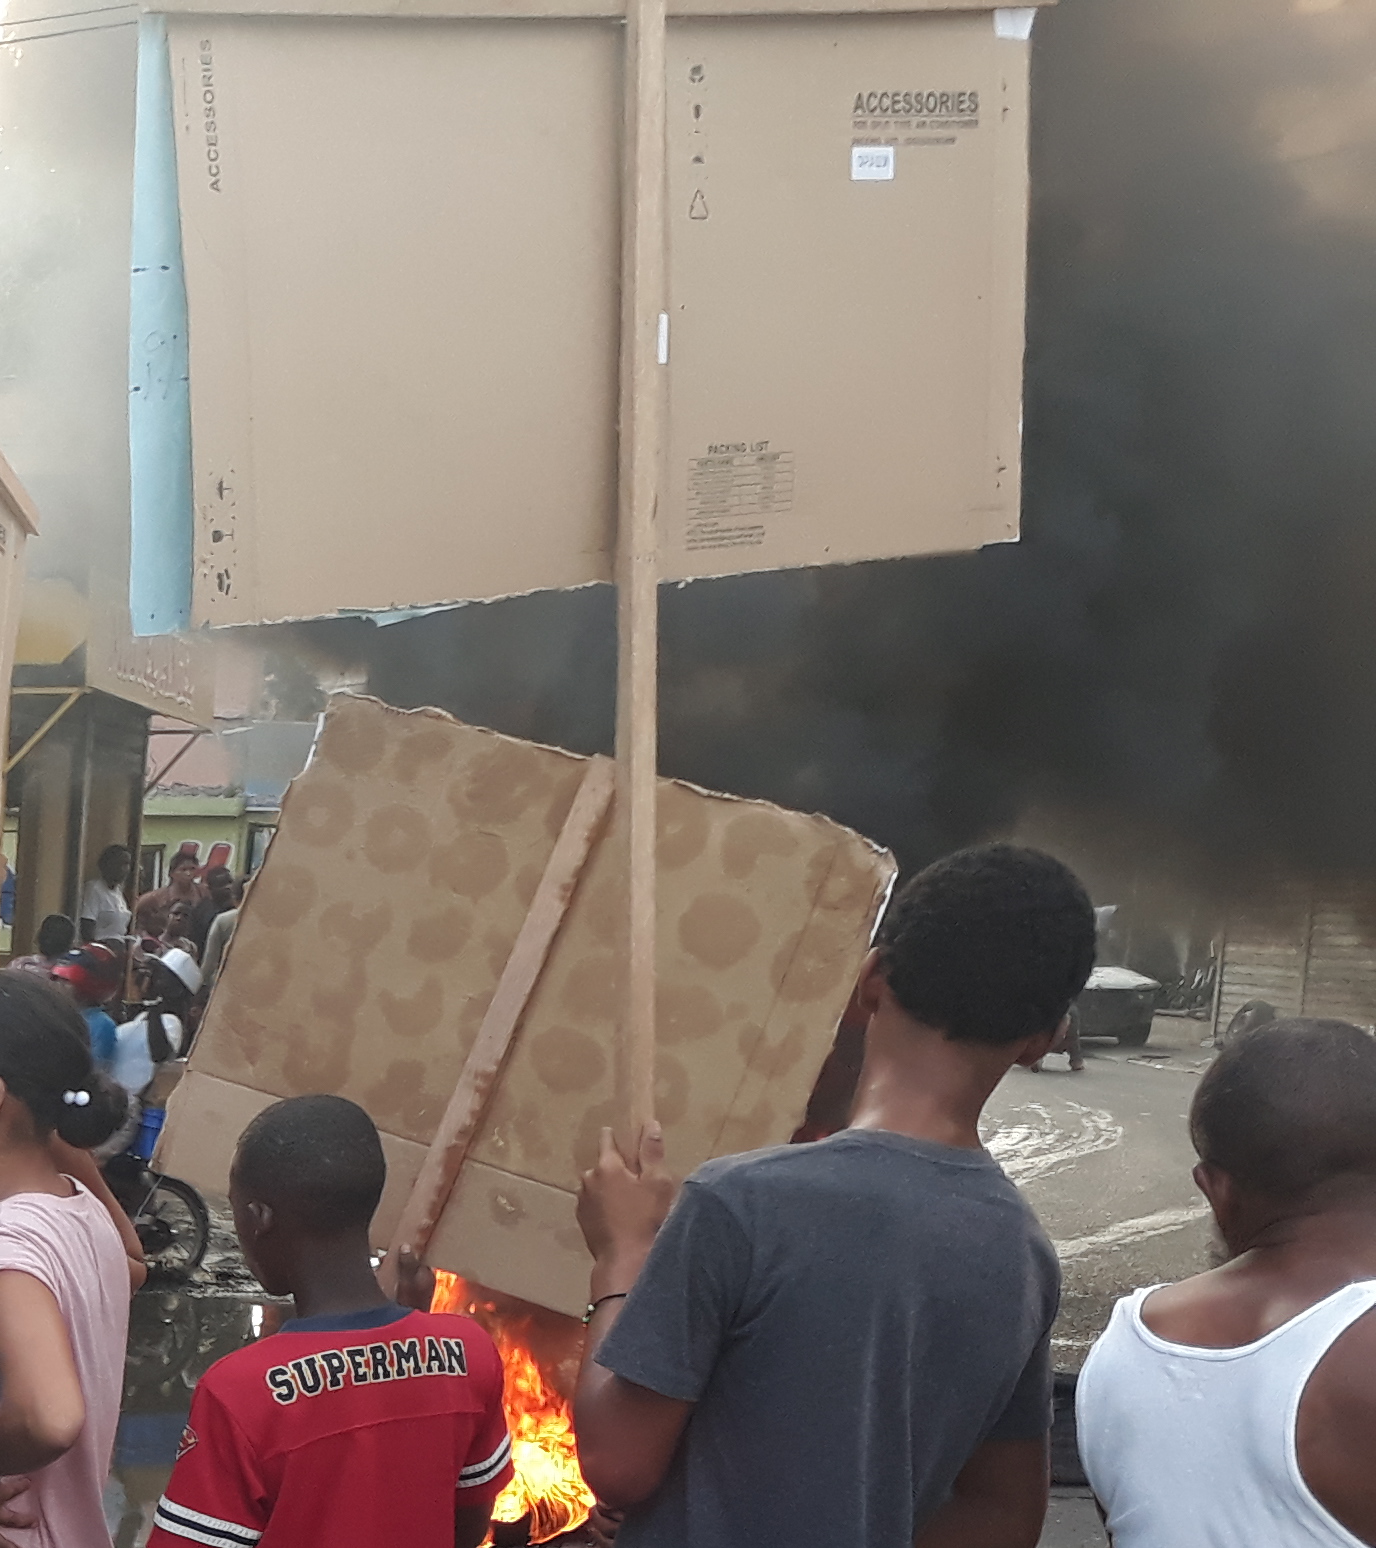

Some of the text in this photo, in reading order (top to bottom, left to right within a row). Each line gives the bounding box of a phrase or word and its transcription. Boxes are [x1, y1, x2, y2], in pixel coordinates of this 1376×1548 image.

[200, 38, 221, 193] ACCESSORIES
[852, 91, 979, 114] ACCESSORIES
[266, 1336, 468, 1405] SUPERMAN
